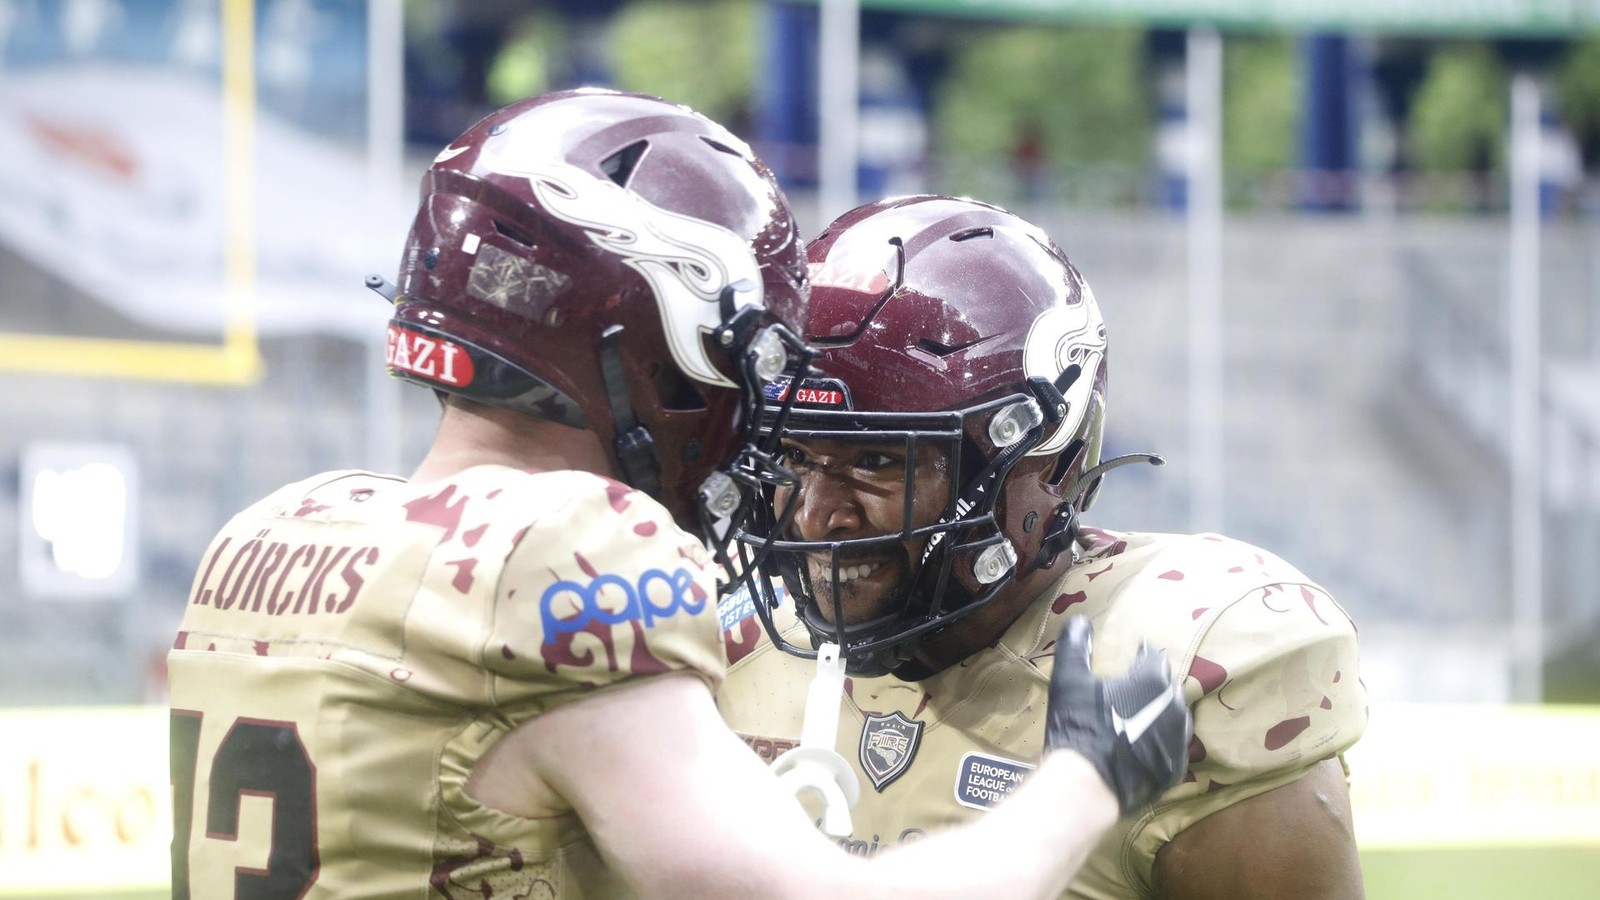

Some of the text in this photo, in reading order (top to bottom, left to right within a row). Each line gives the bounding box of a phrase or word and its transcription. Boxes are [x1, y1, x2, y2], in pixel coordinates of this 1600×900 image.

[193, 529, 379, 616] LÖRCKS
[540, 568, 707, 645] pape
[867, 731, 909, 756] FIRE
[968, 774, 1006, 792] LEAGUE
[970, 762, 1024, 784] EUROPEAN
